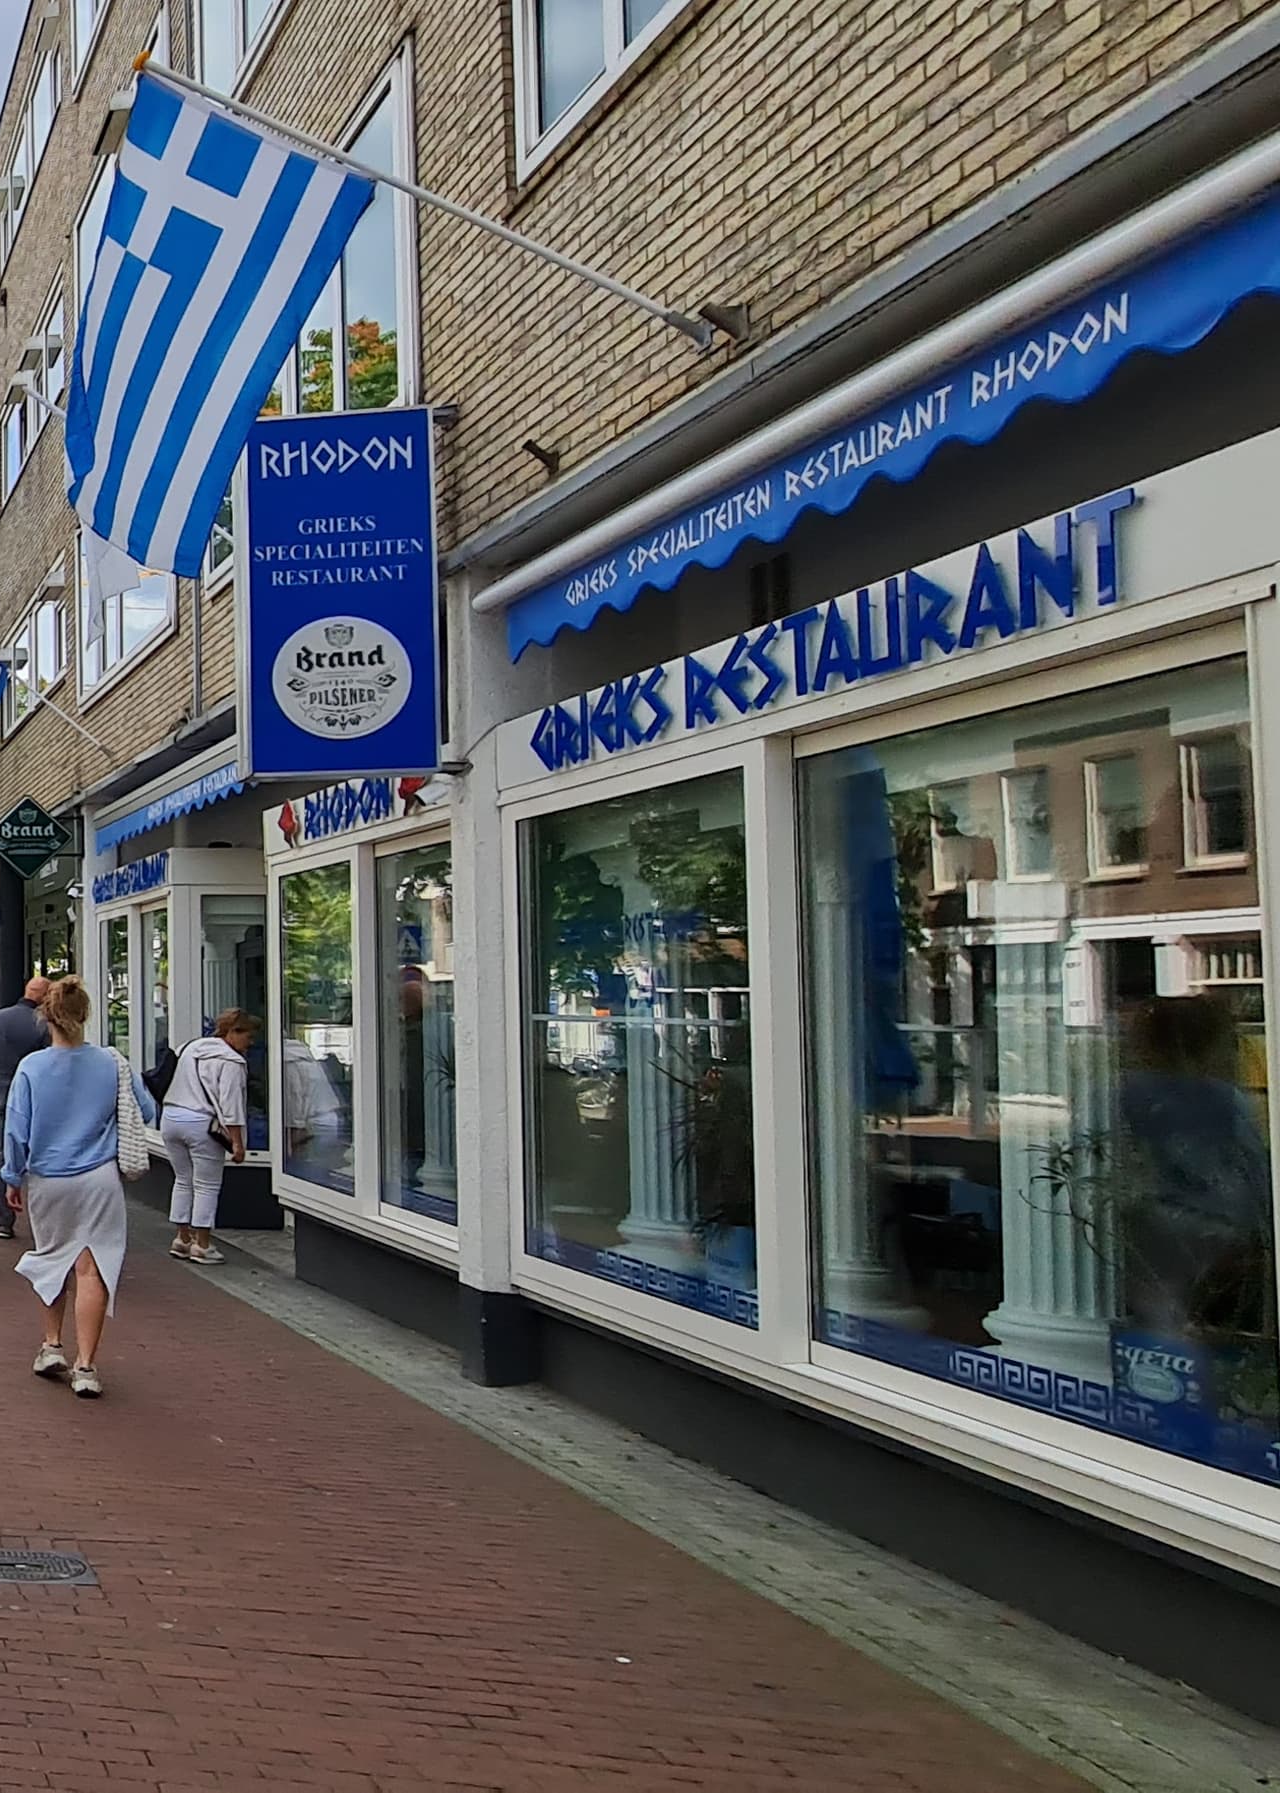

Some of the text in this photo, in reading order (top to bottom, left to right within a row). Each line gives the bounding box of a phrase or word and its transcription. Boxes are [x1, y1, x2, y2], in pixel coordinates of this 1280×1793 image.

[261, 435, 413, 479] RHODON
[565, 292, 1131, 606] GRIEKS SPECIALITEITEN RESTAURANT RHODON
[298, 515, 377, 535] GRIEKS
[253, 538, 424, 563] SPECIALITEITEN
[271, 564, 408, 586] RESTAURANT
[530, 487, 1138, 772] GRIEKS RESTAURANT
[296, 644, 385, 673] Brand
[308, 688, 377, 706] PILSENER
[304, 777, 390, 840] RHODON
[1, 822, 55, 839] Brand
